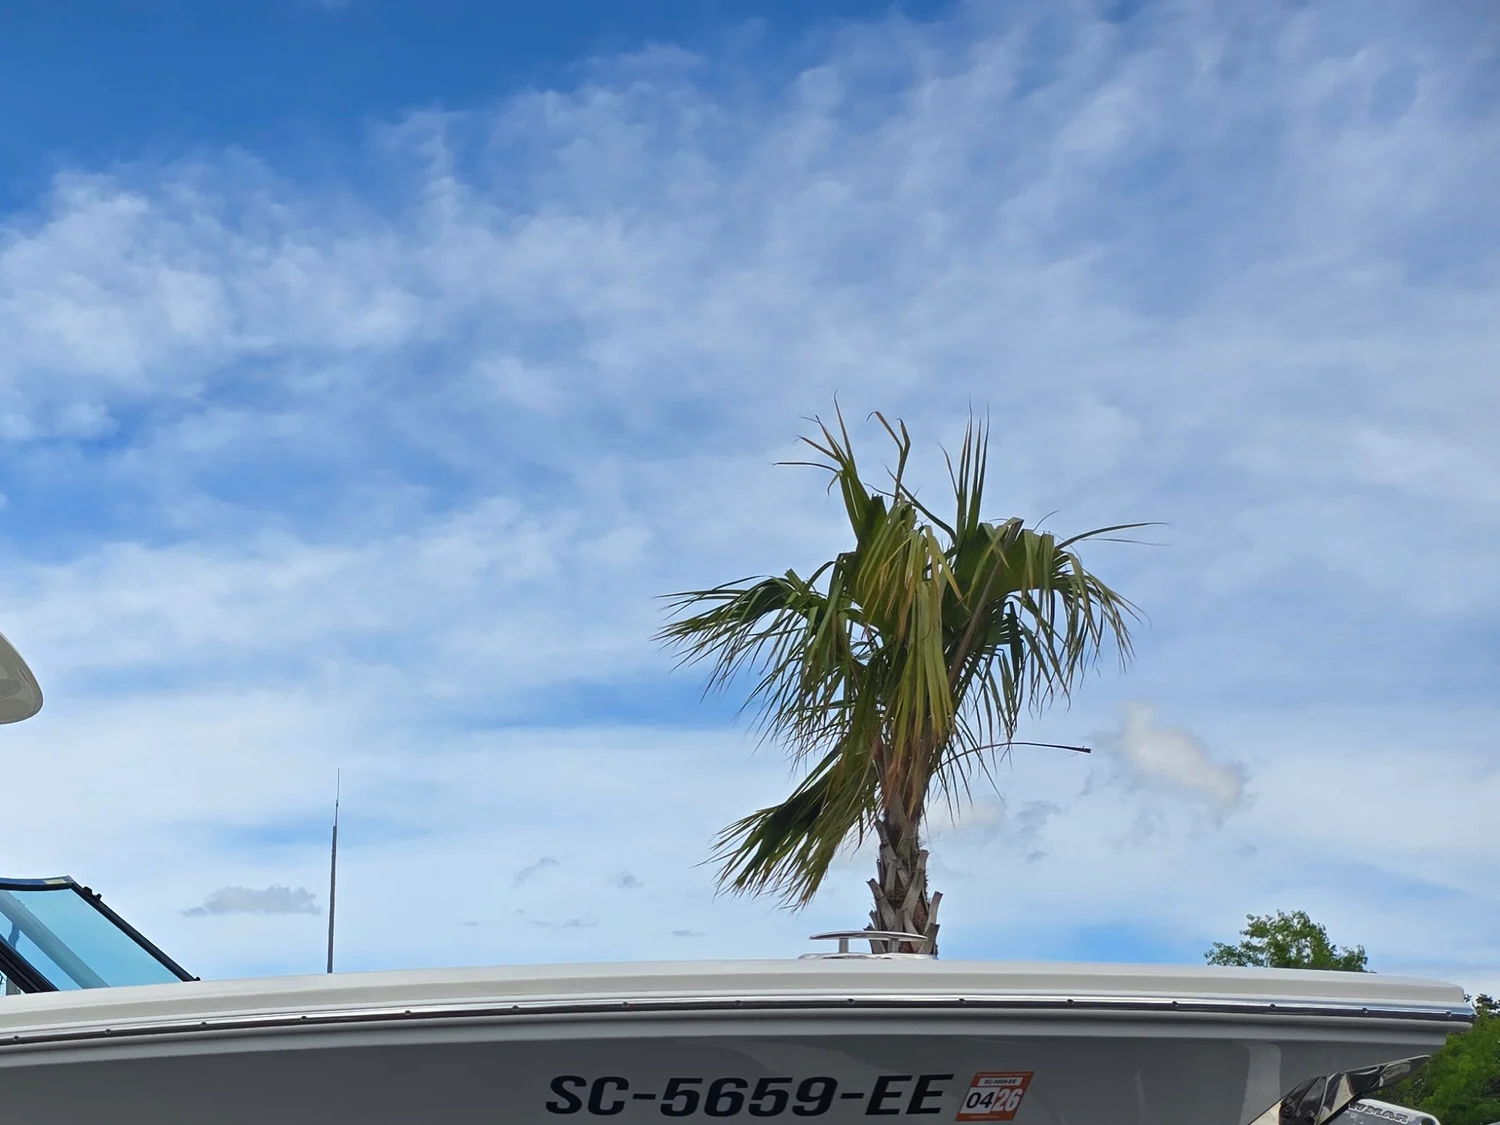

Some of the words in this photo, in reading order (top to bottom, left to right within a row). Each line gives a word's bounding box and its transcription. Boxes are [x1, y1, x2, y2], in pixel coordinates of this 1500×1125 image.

[545, 1073, 954, 1117] SC-5659-EE
[966, 1091, 995, 1109] 04
[991, 1088, 1023, 1112] 26
